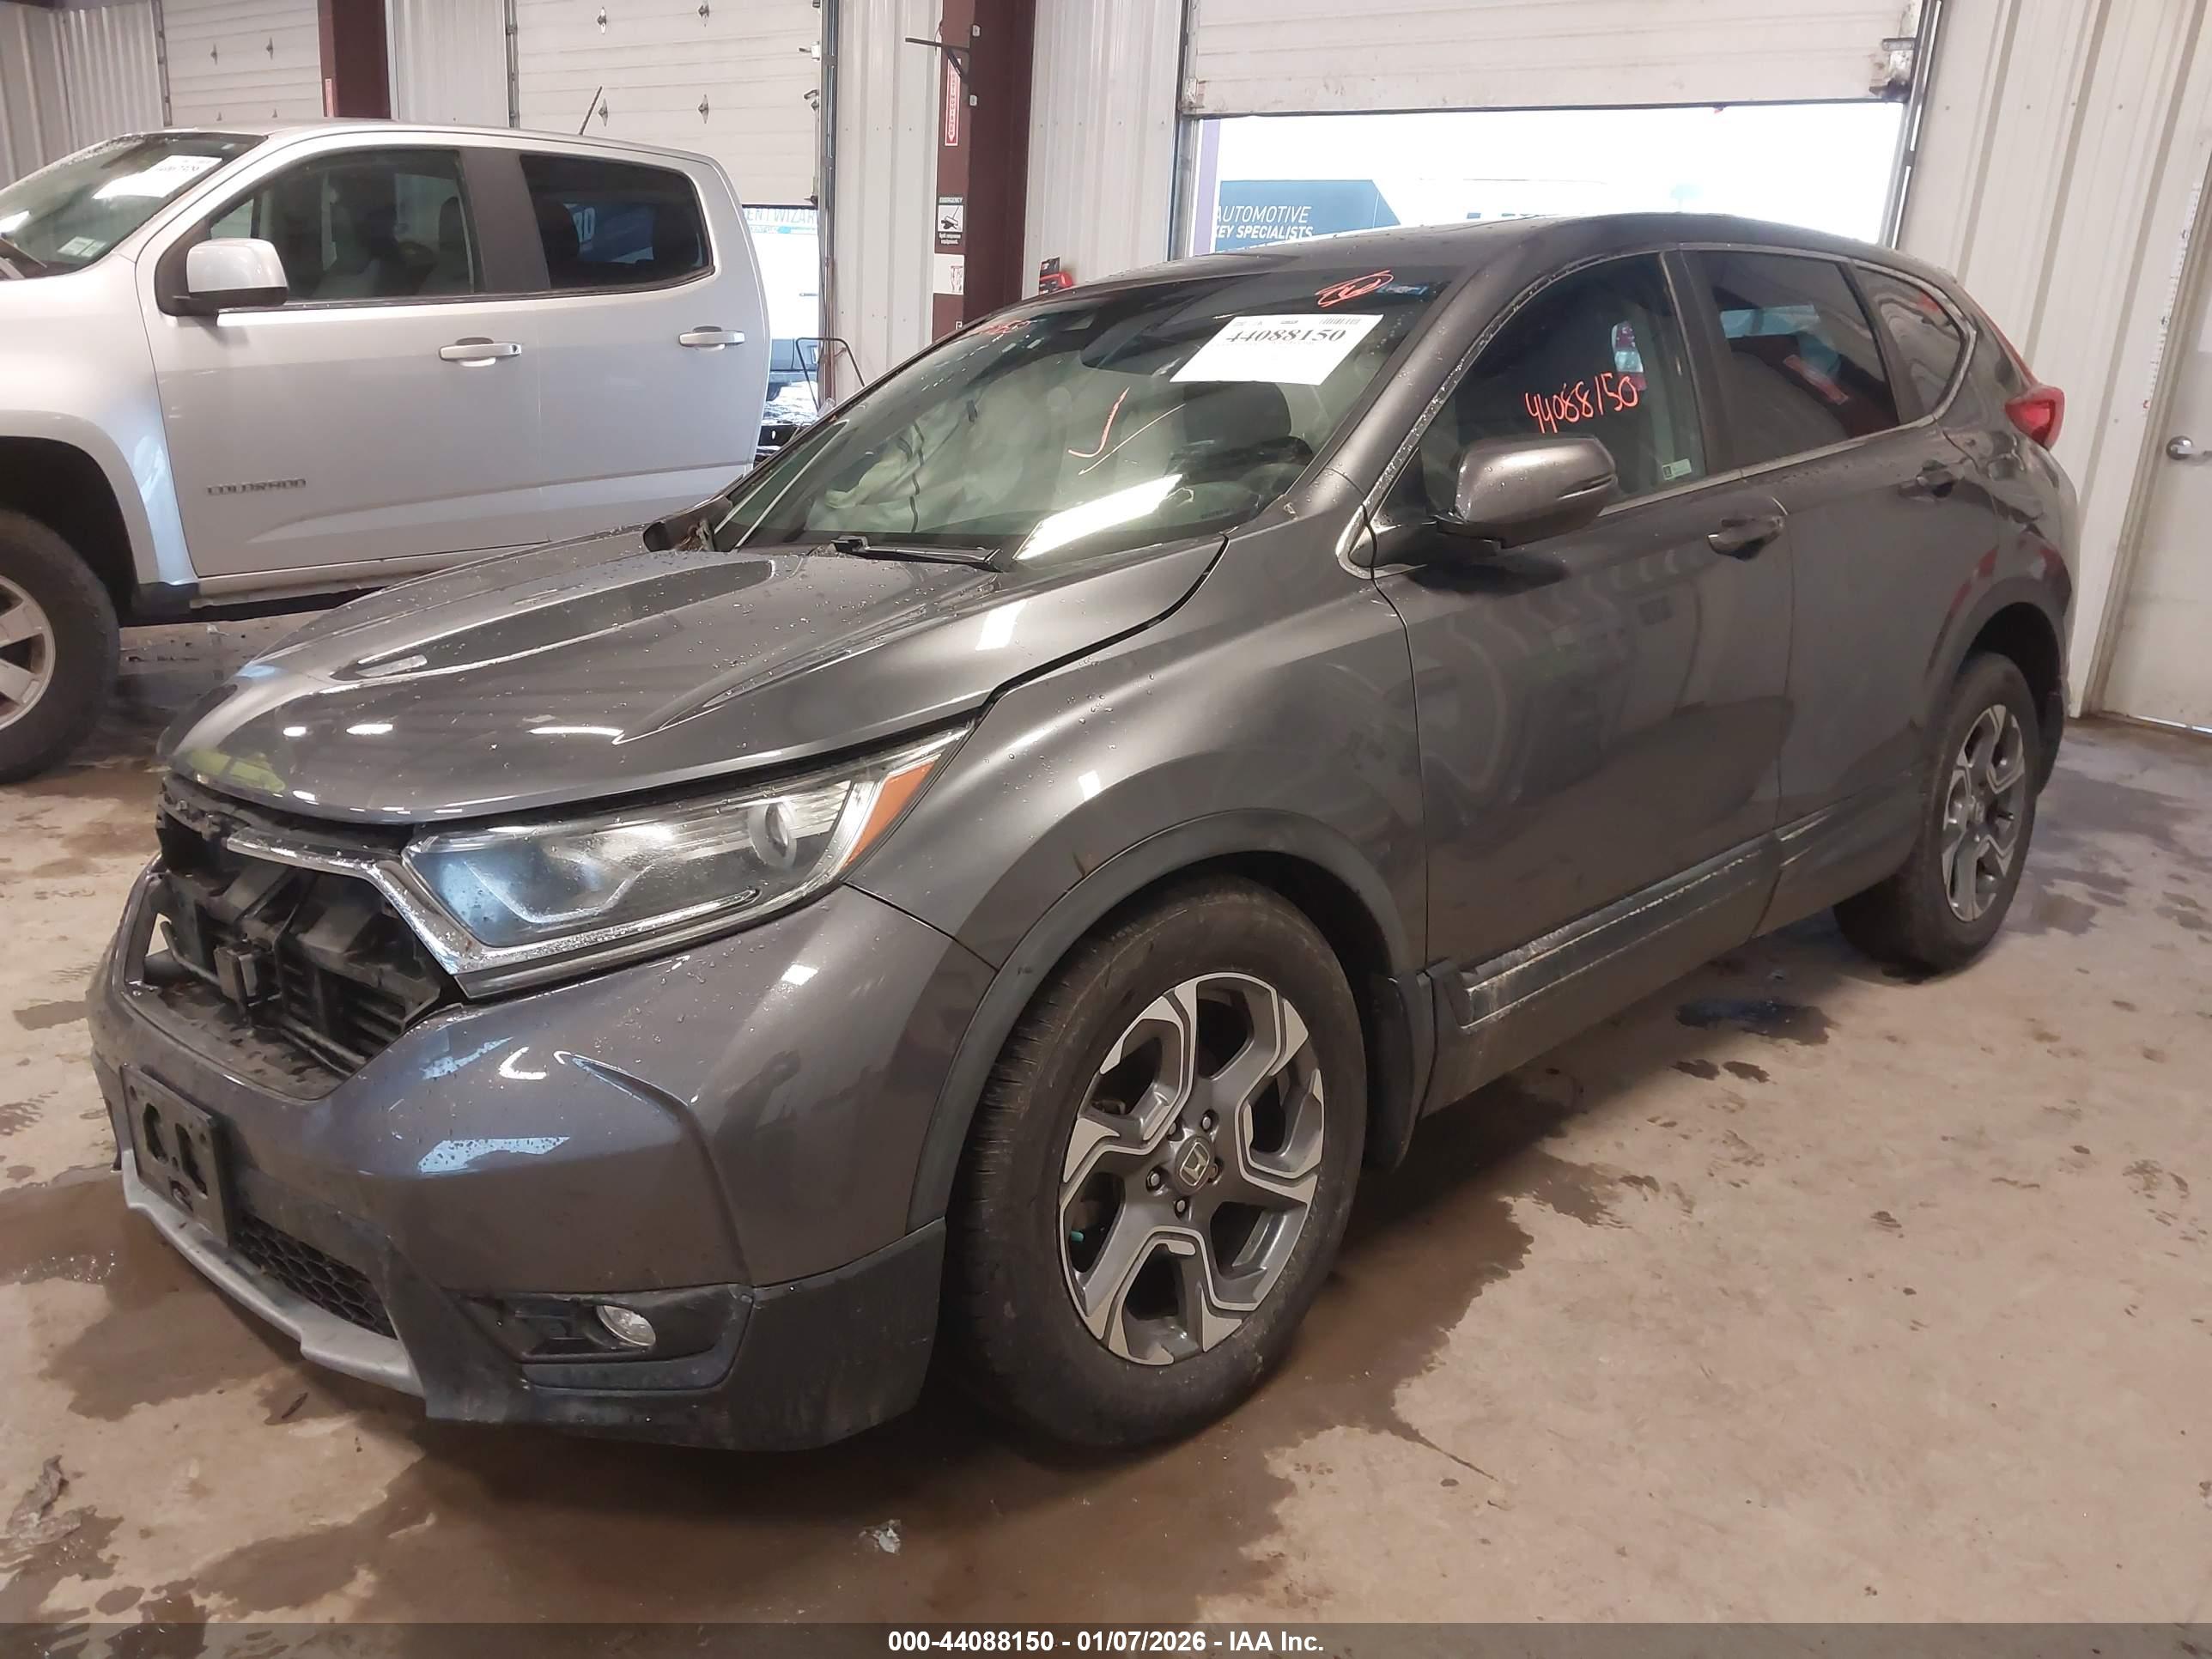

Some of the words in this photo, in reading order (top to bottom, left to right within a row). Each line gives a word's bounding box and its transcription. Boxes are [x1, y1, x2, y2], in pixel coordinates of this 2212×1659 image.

[1216, 205, 1312, 223] AUTOMOTIVE
[1237, 225, 1314, 240] SPECIALISTS
[1226, 329, 1346, 343] 44088150
[207, 477, 307, 495] COLORADO
